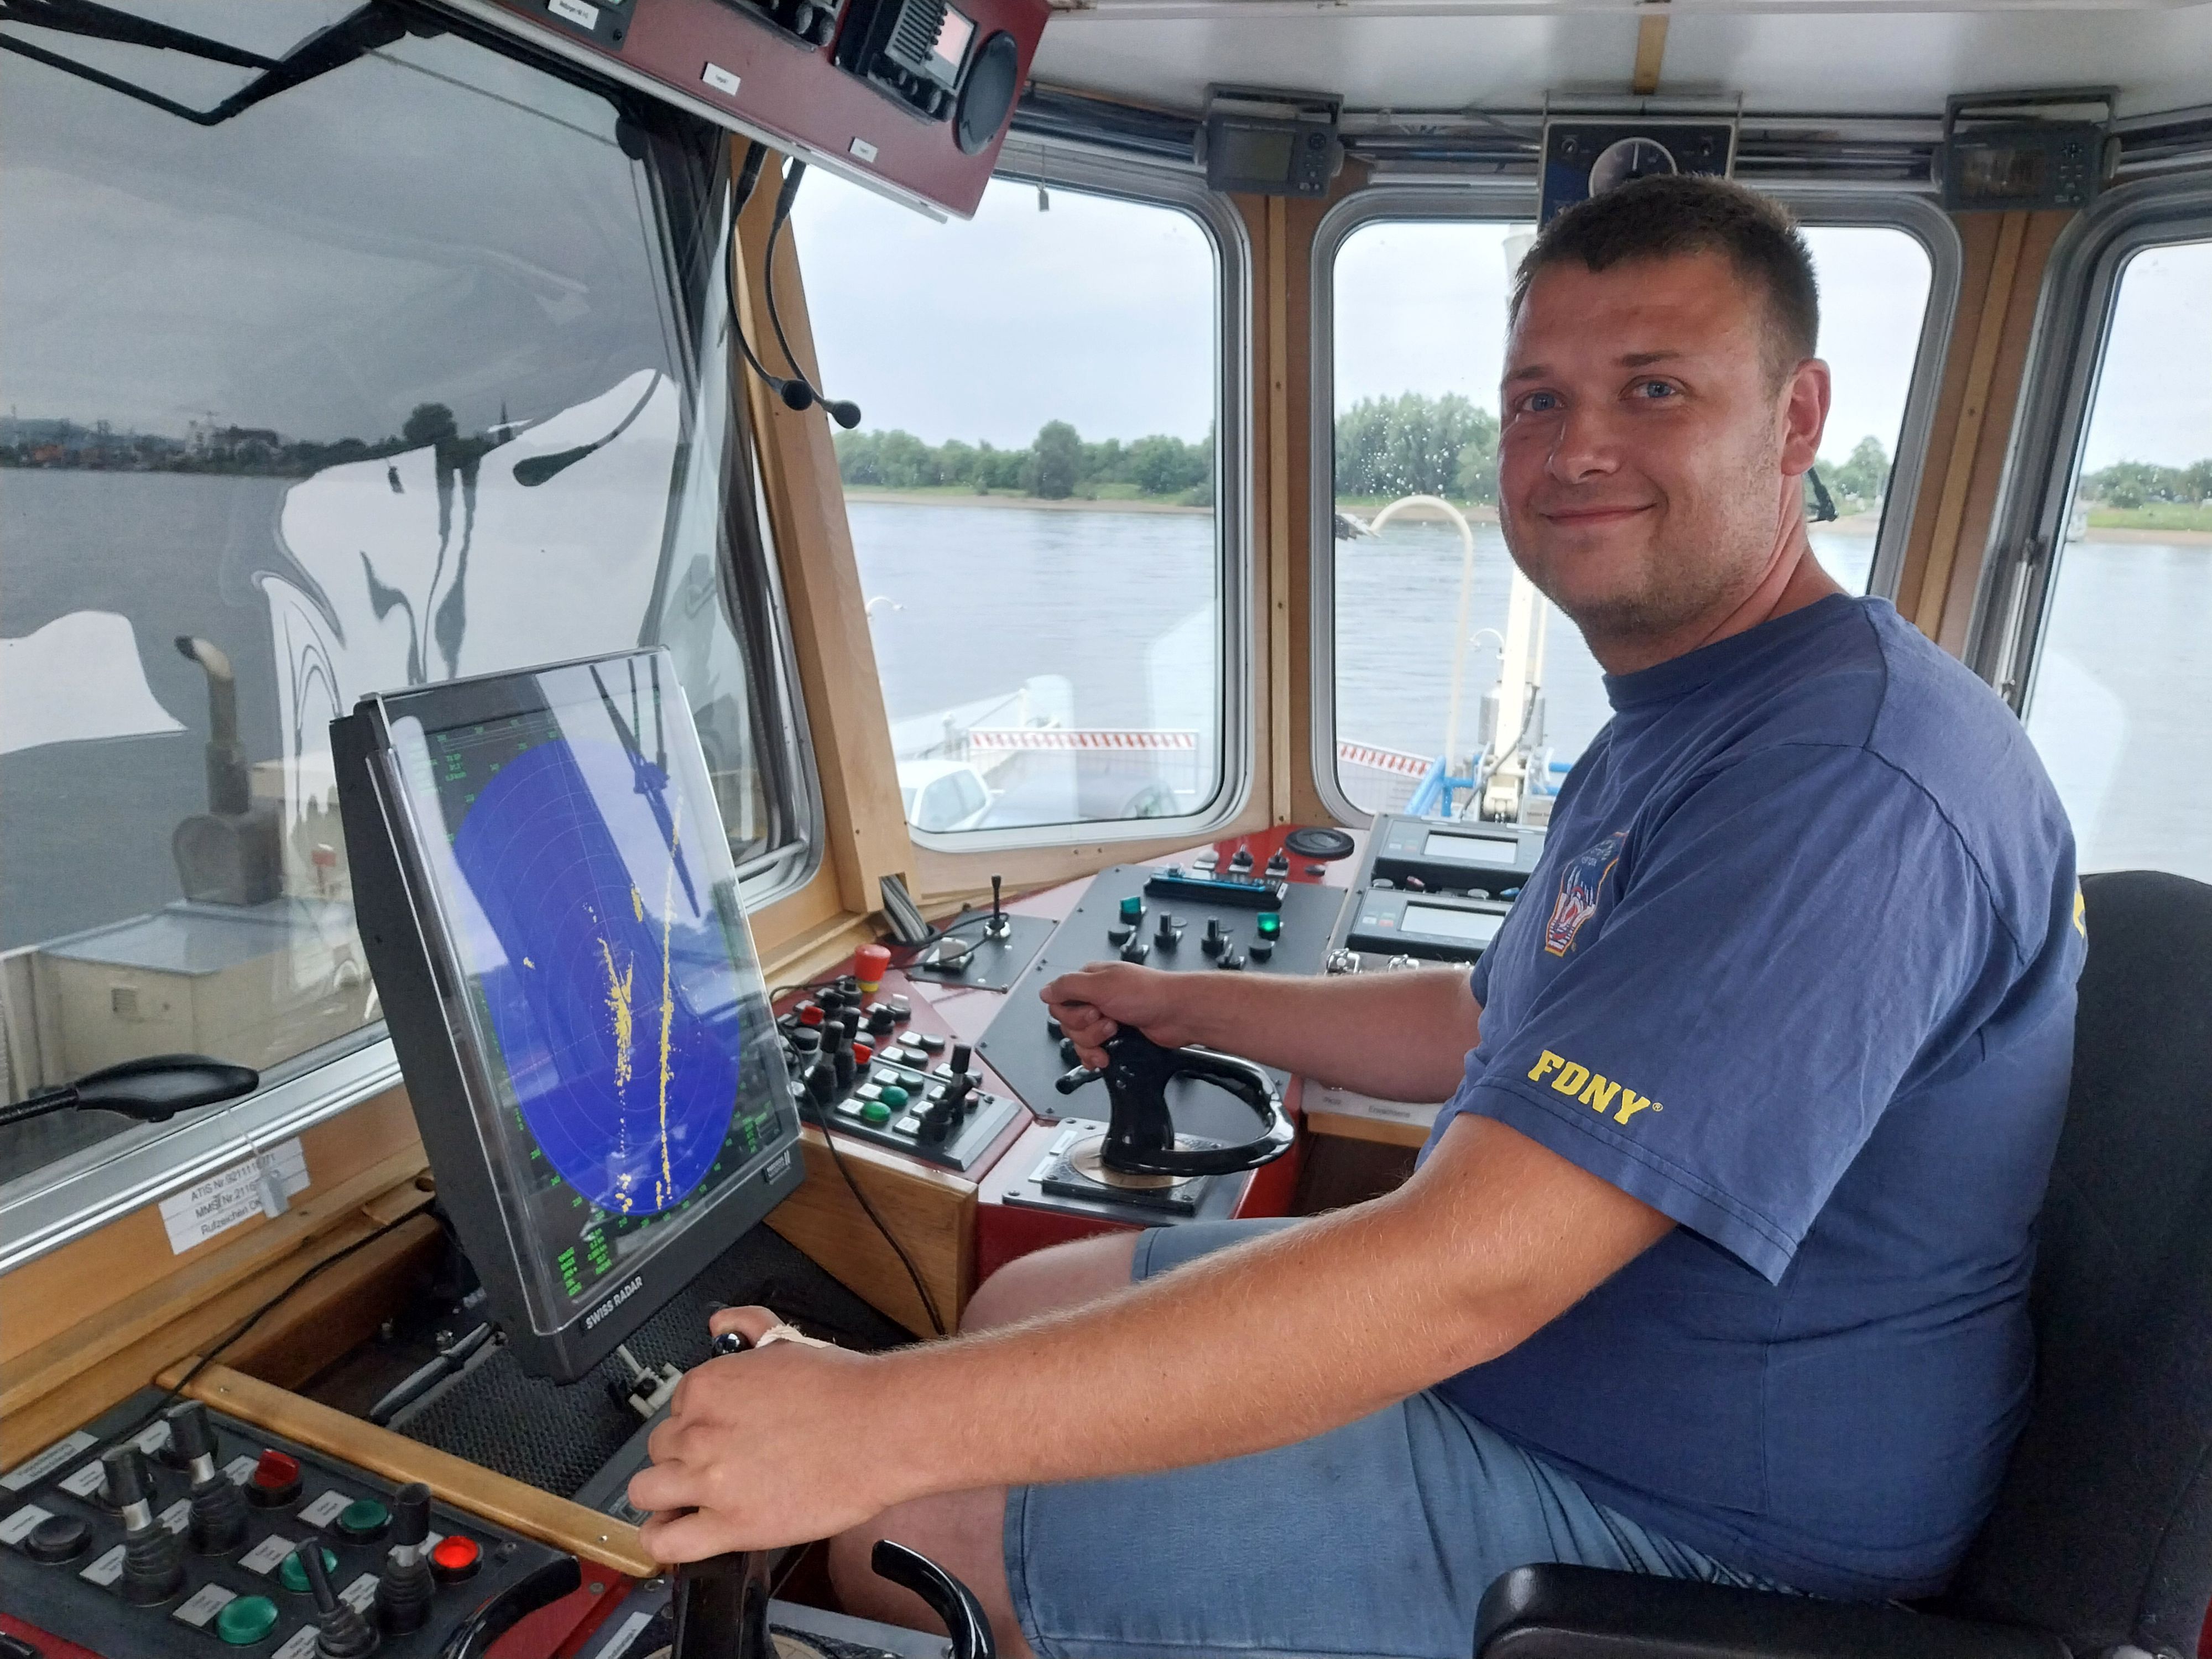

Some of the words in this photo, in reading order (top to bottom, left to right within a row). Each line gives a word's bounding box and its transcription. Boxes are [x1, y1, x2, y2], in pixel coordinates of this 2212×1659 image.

[191, 1183, 212, 1201] ATIS
[201, 1206, 248, 1234] Rufzeichen
[586, 1300, 614, 1329] SWISS
[613, 1276, 643, 1307] RADAR
